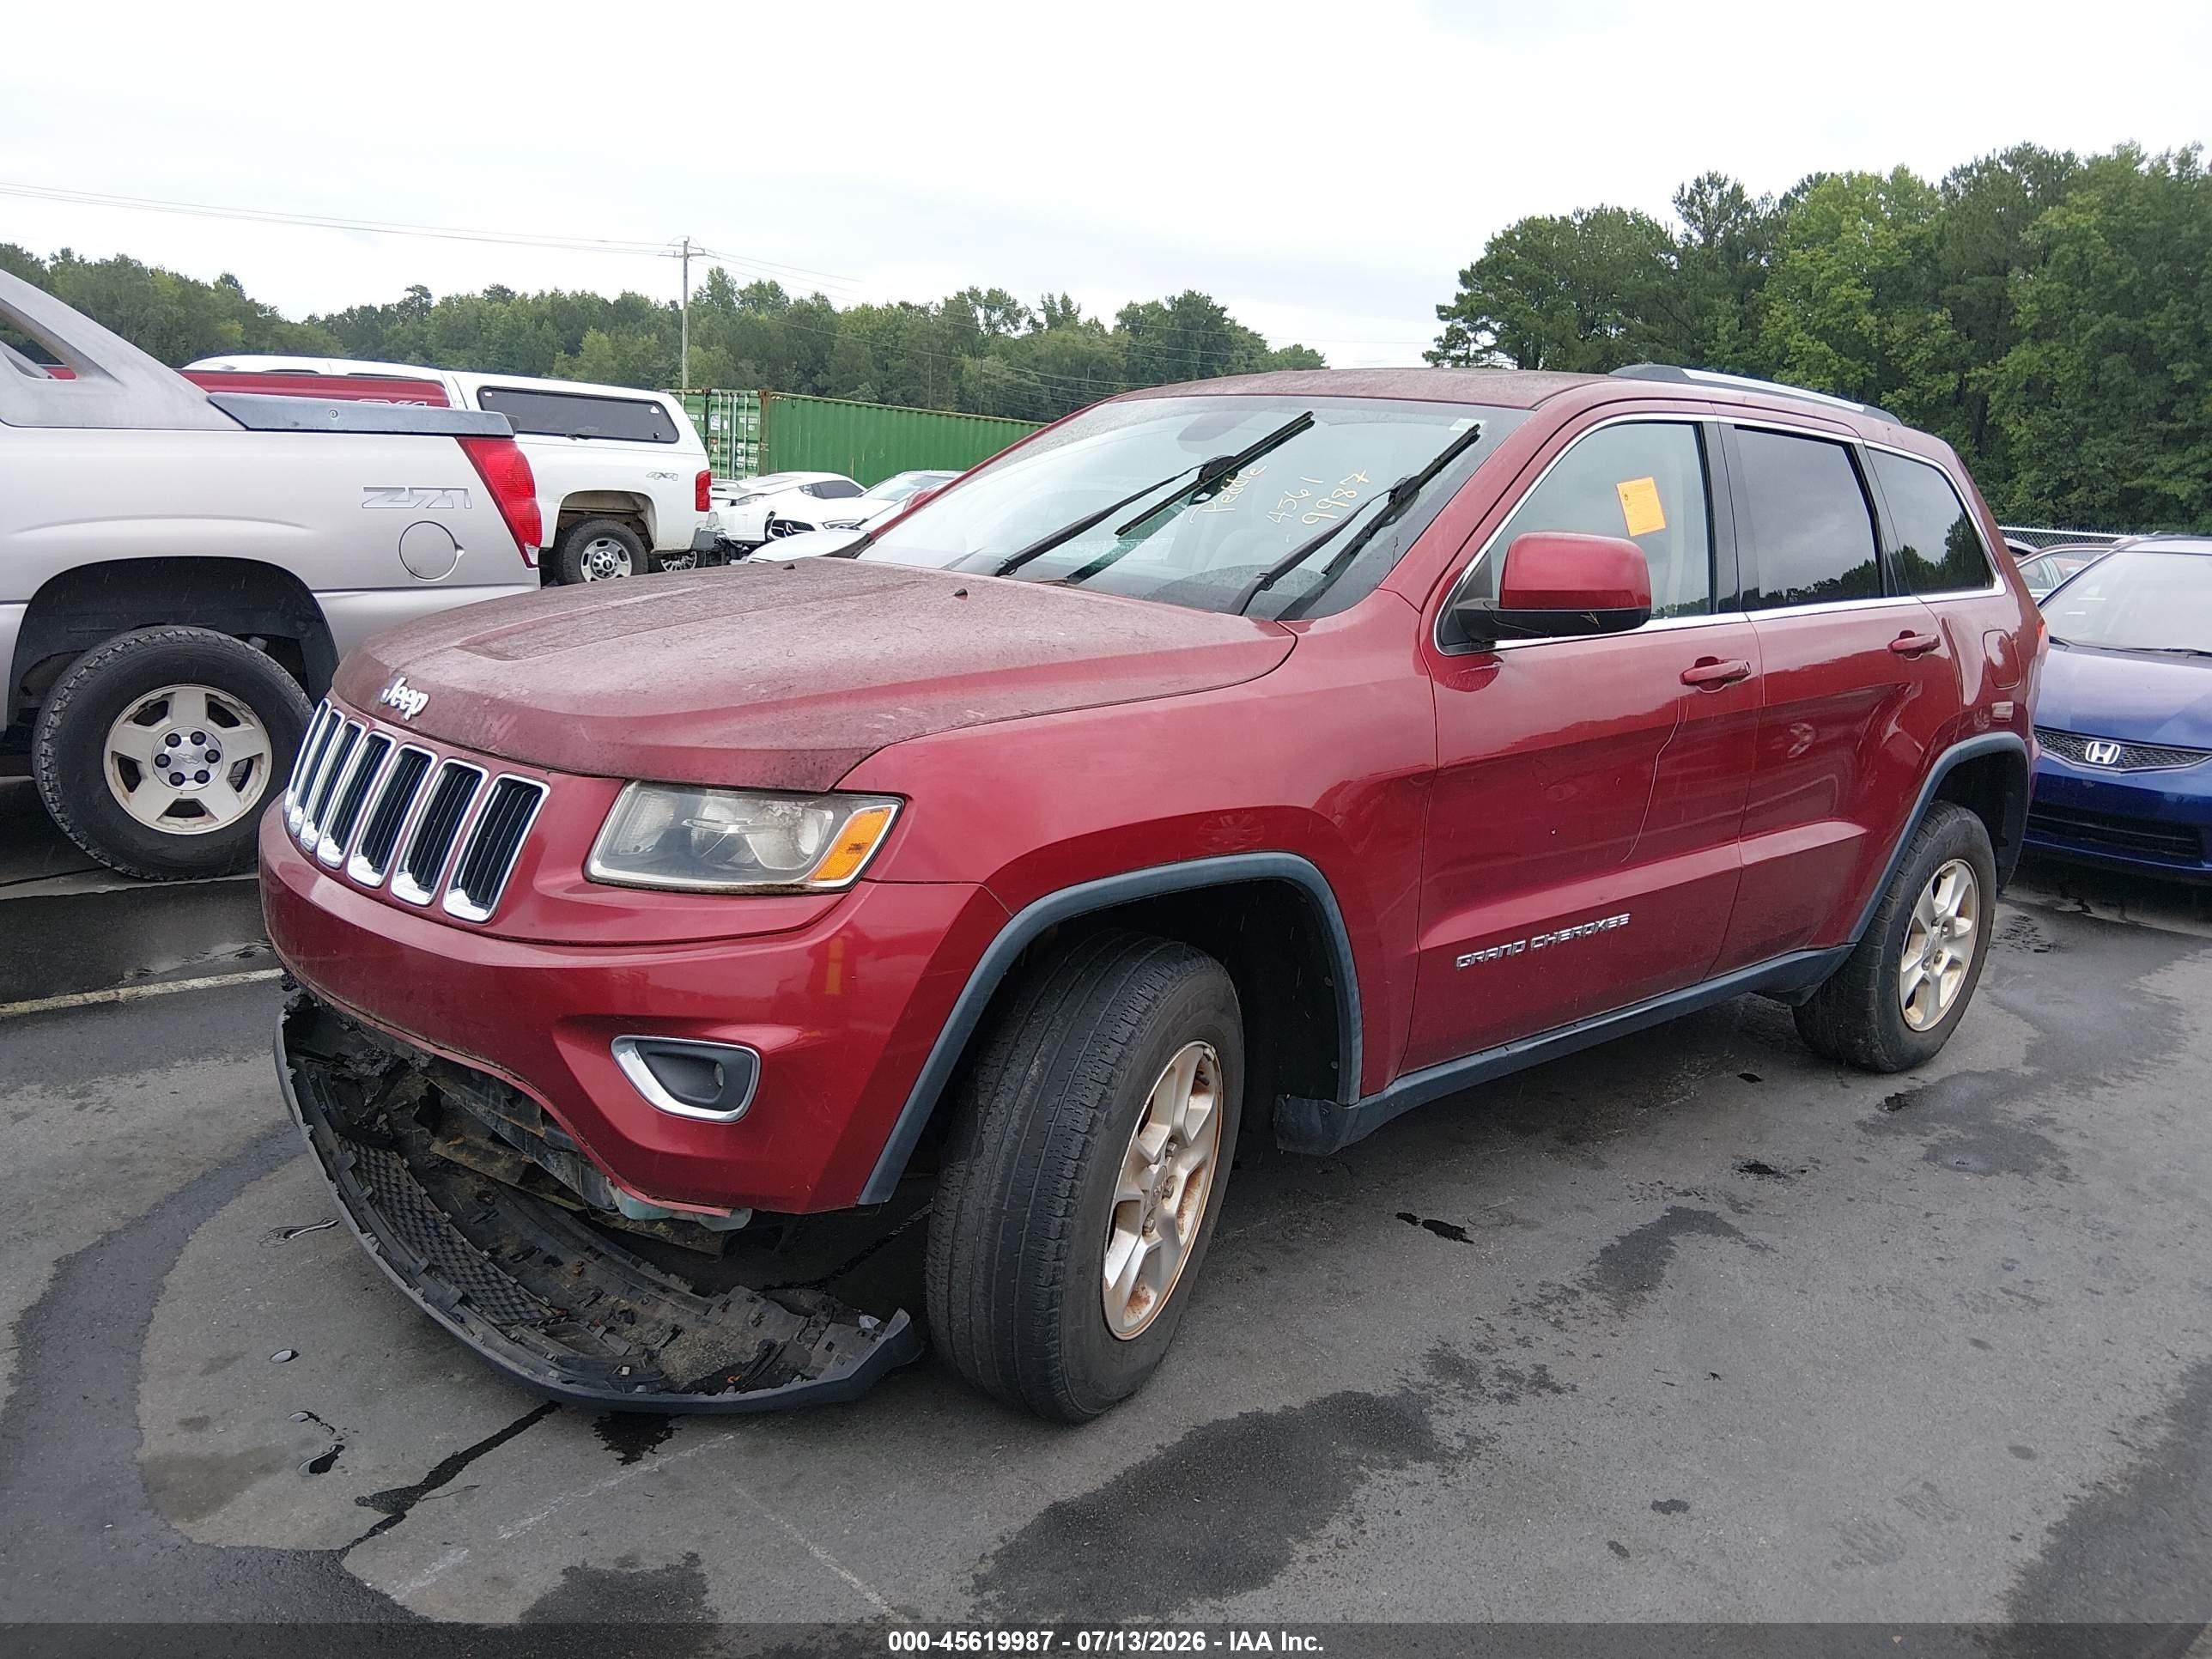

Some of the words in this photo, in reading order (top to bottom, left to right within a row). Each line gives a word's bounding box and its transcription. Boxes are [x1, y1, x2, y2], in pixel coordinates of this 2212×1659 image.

[362, 486, 472, 509] Z71
[1265, 476, 1324, 524] 4561
[1301, 469, 1370, 525] 9987
[380, 677, 430, 721] Jeep
[1456, 939, 1526, 968] GRAND
[1531, 913, 1631, 949] CHEROKEE
